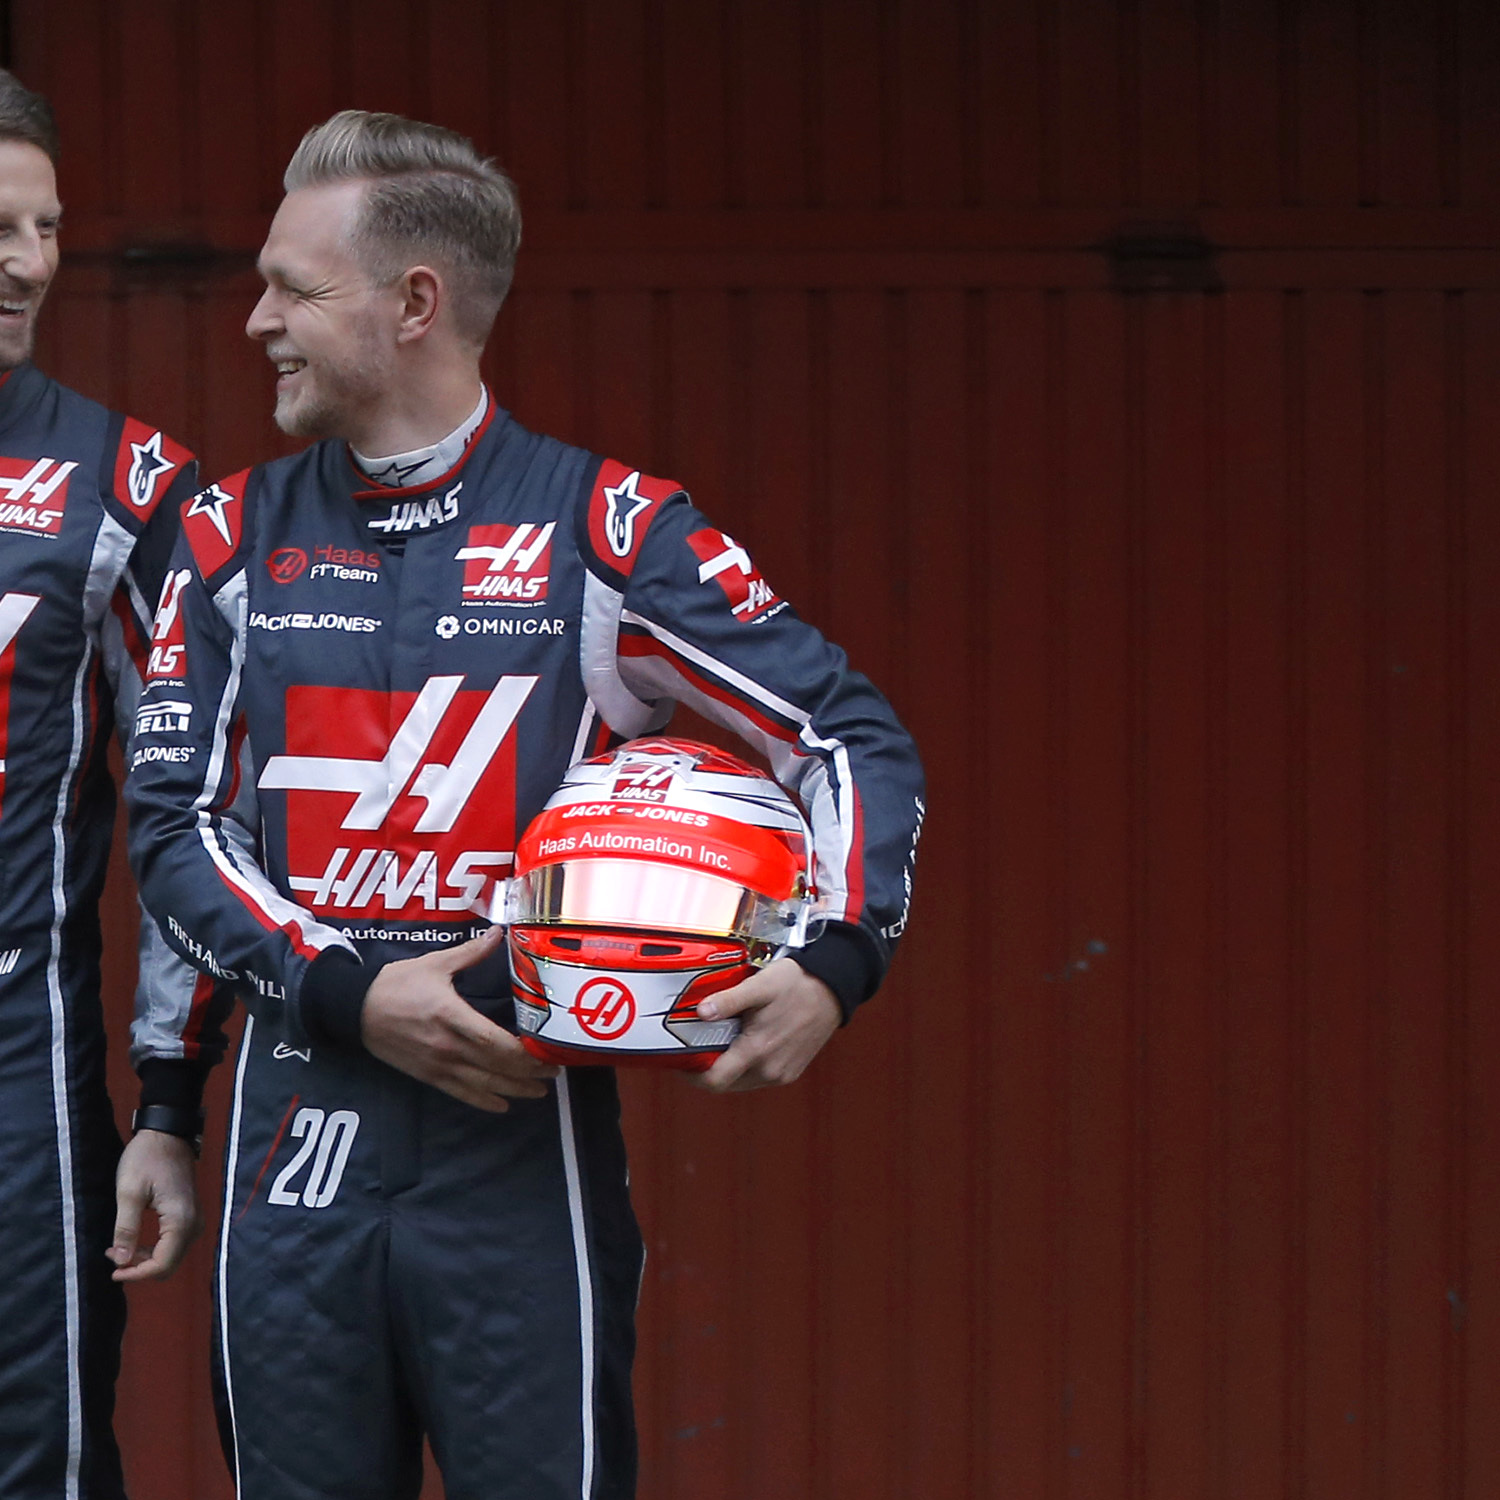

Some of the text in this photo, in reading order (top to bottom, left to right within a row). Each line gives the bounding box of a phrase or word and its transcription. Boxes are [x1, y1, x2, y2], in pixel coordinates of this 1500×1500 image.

[368, 481, 463, 532] HAAS
[313, 544, 382, 568] Haas
[462, 575, 549, 598] HAAS
[464, 618, 565, 635] OMNICAR
[634, 807, 709, 828] JONES
[538, 832, 732, 871] Haas Automation Inc.
[287, 847, 515, 911] HAAS
[339, 926, 464, 943] Automation
[267, 1107, 361, 1209] 20
